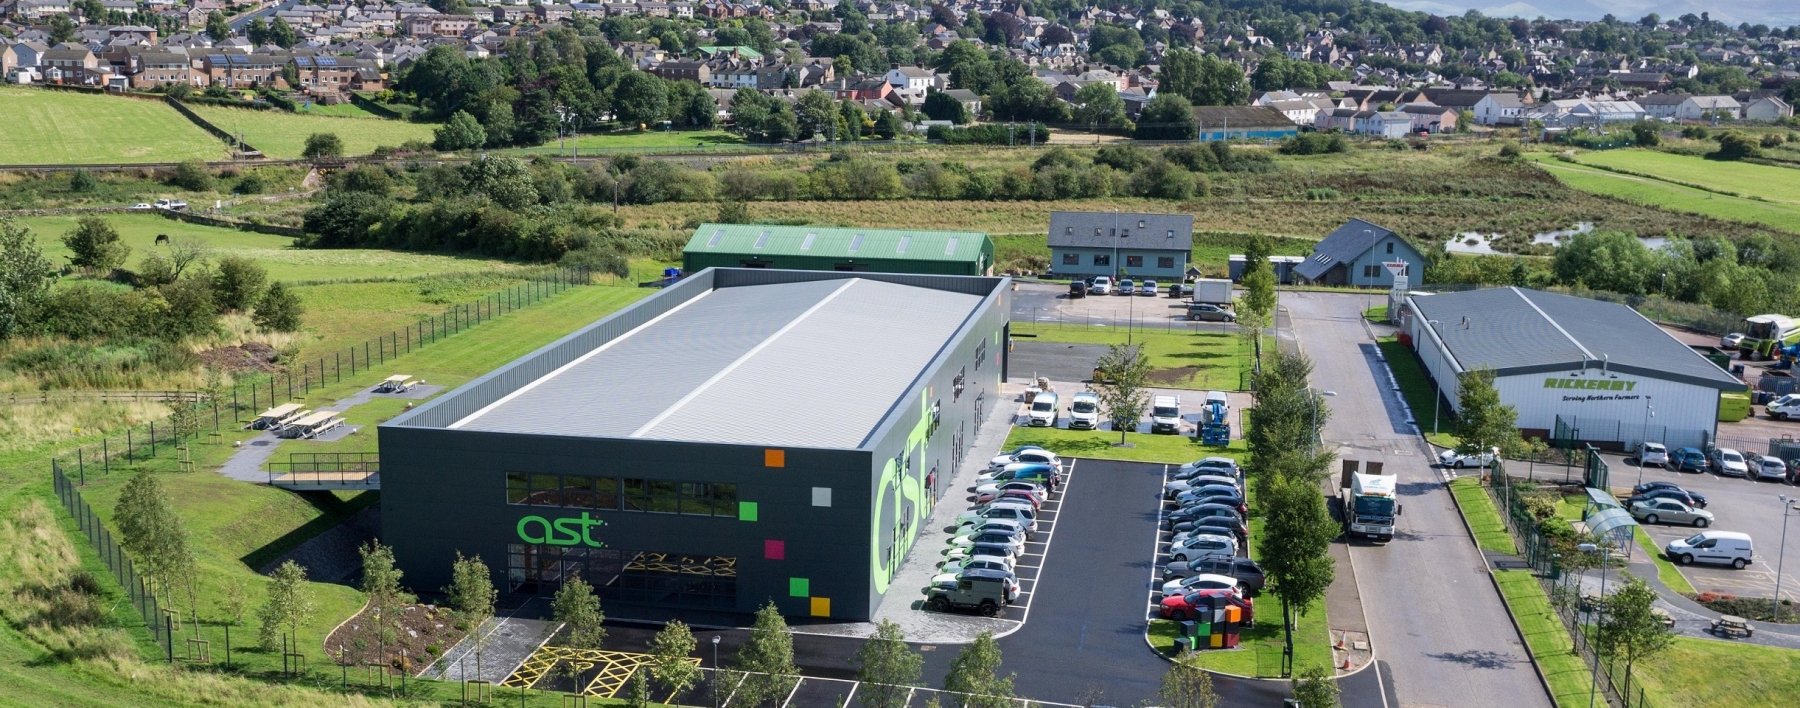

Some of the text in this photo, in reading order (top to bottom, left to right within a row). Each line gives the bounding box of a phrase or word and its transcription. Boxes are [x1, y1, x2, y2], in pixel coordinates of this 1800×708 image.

[1544, 378, 1637, 391] RICKERBY
[1562, 395, 1586, 403] Serving
[516, 512, 606, 548] ast
